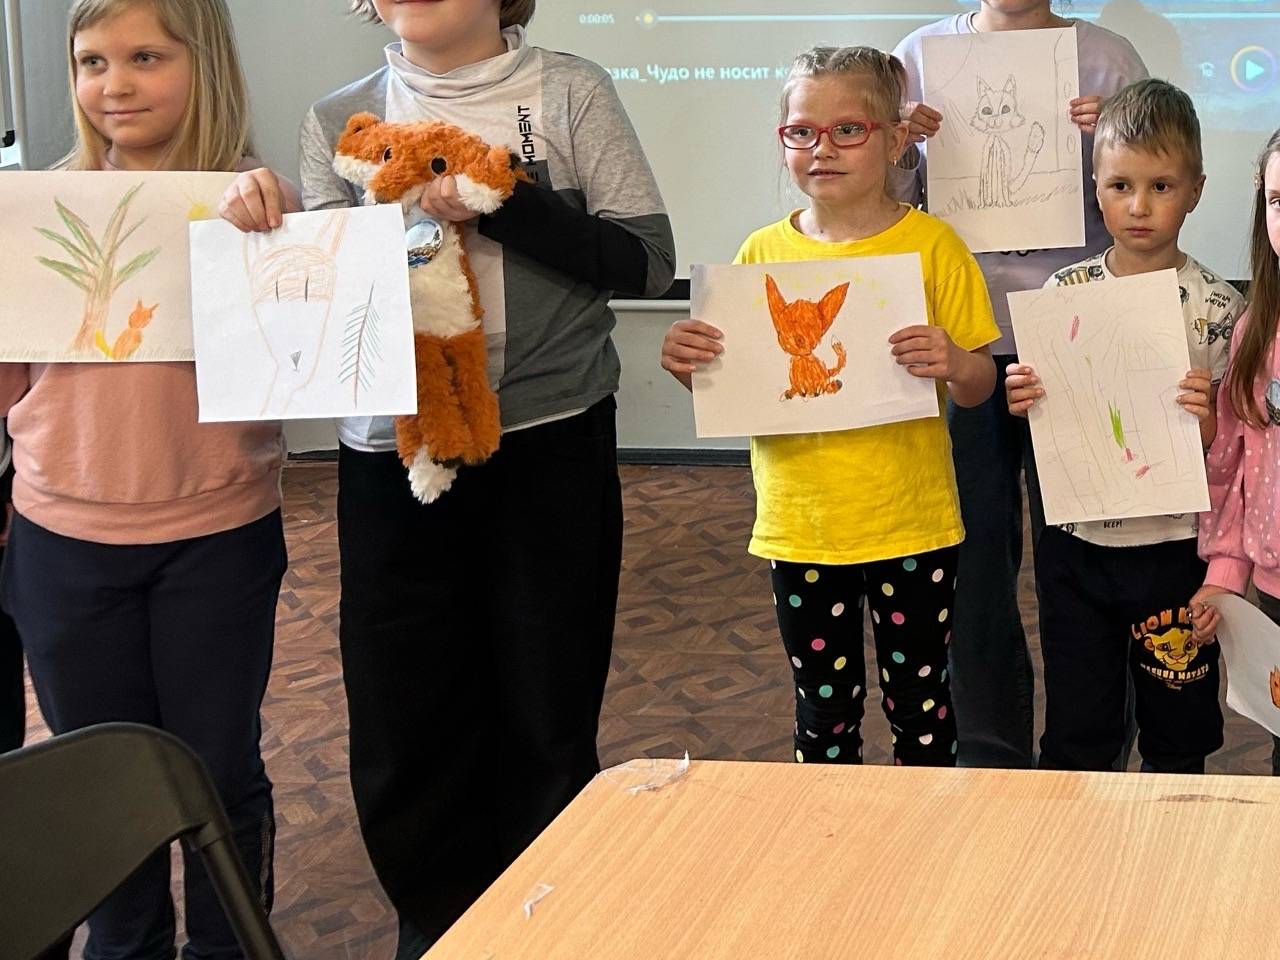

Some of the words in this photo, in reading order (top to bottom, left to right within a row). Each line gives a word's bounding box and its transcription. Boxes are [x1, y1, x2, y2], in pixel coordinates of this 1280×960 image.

[695, 66, 716, 80] не
[720, 66, 769, 80] носит
[517, 105, 536, 165] MOMENT
[1131, 609, 1172, 640] LION
